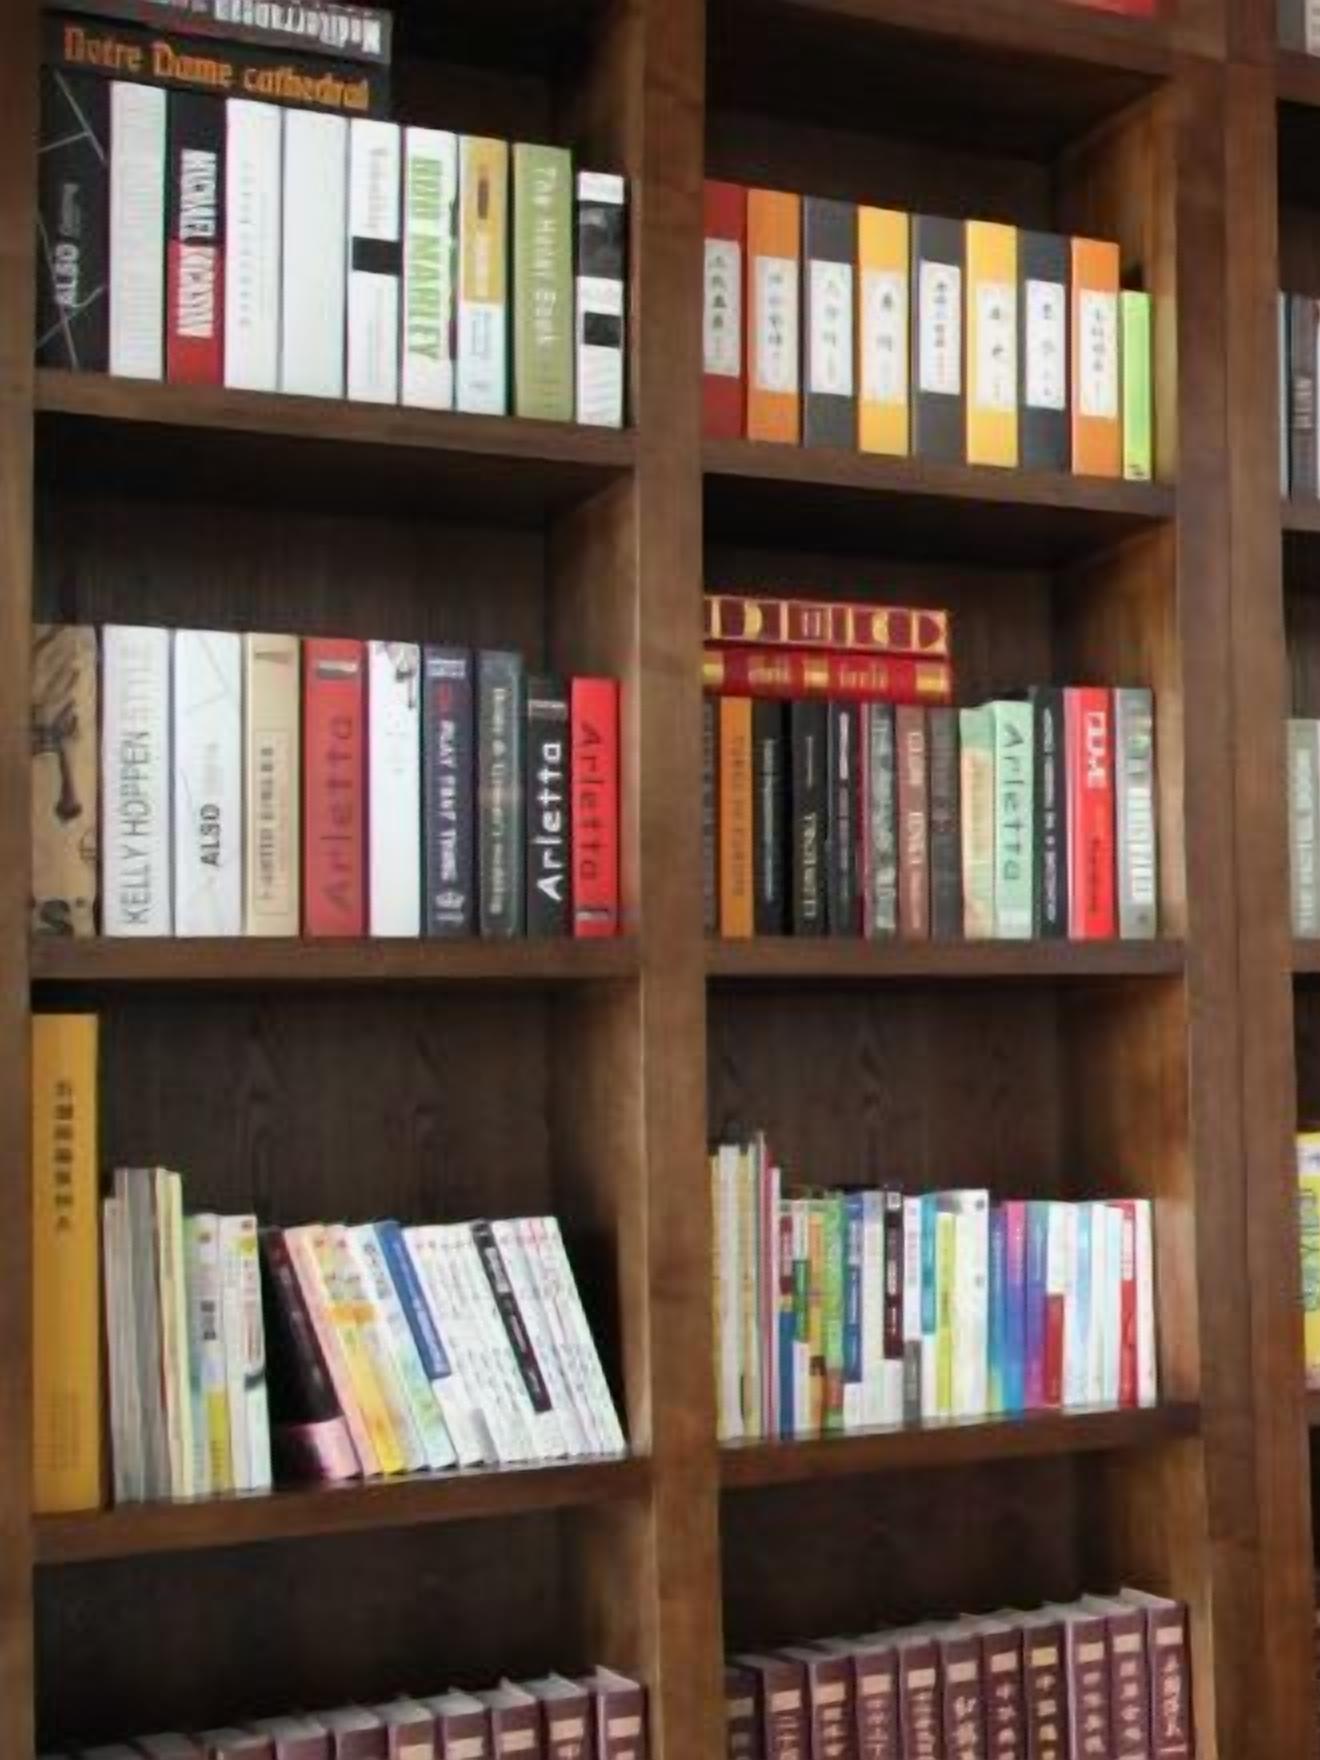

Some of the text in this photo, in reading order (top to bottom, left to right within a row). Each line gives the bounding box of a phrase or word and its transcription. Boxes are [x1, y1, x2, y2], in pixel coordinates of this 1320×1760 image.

[153, 41, 232, 88] Dame
[243, 64, 370, 111] cathedral
[408, 232, 445, 361] MARLEY
[120, 731, 151, 838] HOPPEN
[200, 803, 222, 869] ALSO
[321, 714, 354, 908] Arletta
[537, 740, 563, 902] Arletta
[575, 723, 602, 882] Arletta
[1003, 721, 1026, 882] Arletta
[120, 845, 151, 925] KELLY
